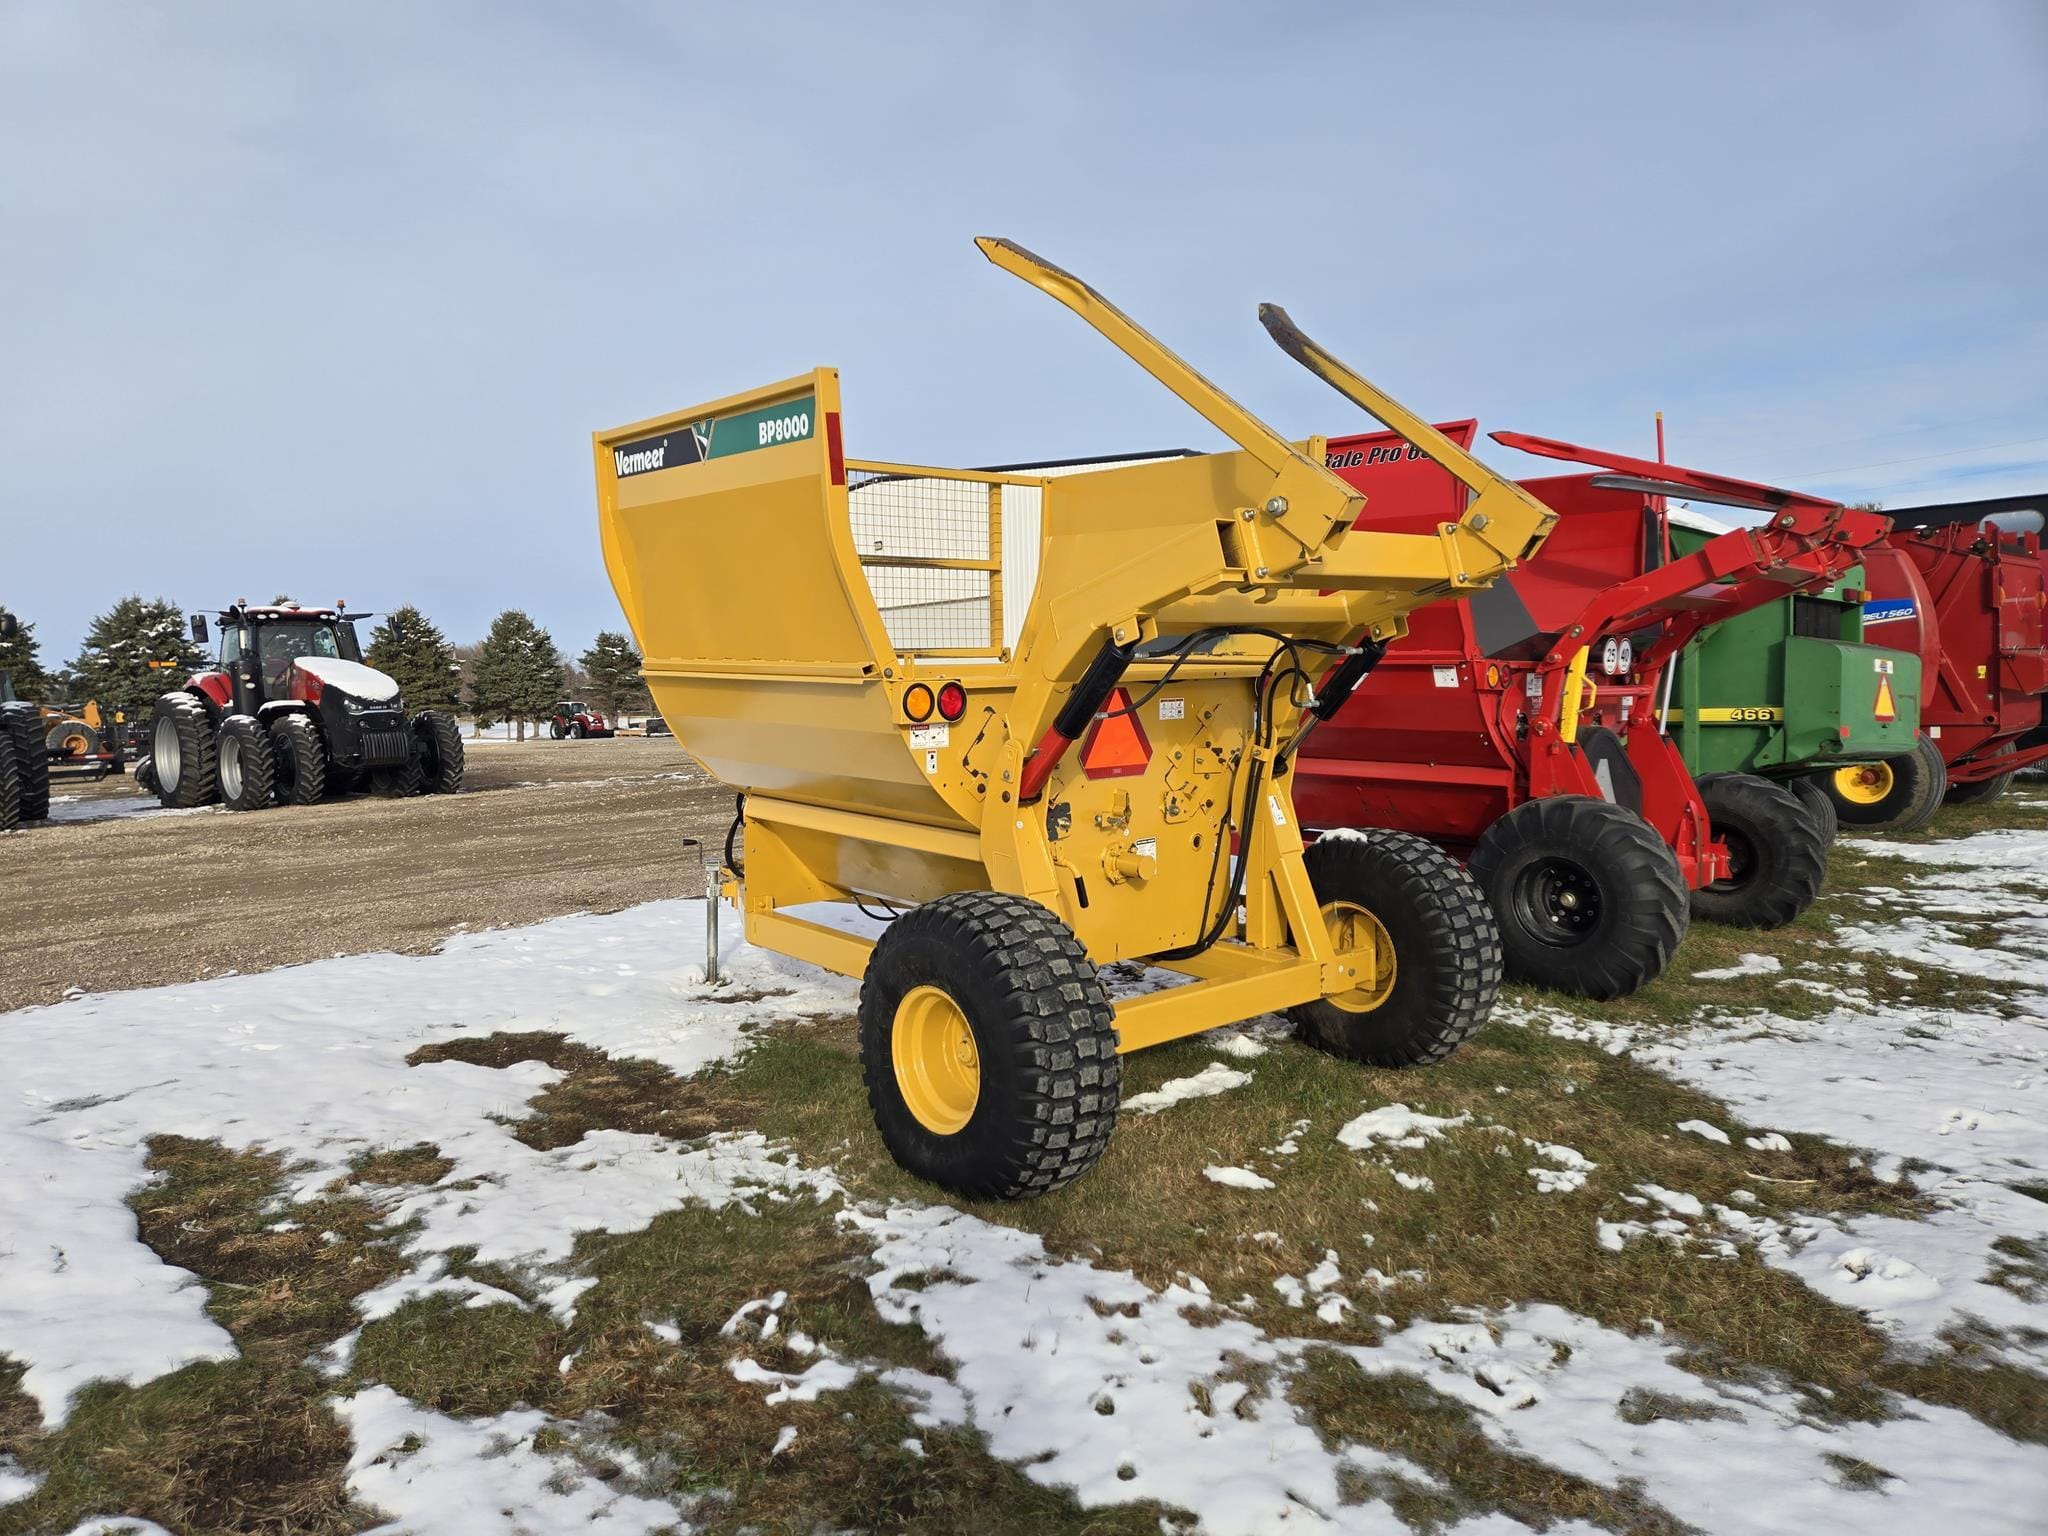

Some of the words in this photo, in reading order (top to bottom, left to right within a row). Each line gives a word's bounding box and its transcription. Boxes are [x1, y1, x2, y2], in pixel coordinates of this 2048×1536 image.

[758, 413, 809, 445] BP8000
[1366, 445, 1402, 465] Pro
[1888, 608, 1913, 618] 560
[1607, 648, 1616, 662] 25
[1620, 648, 1630, 662] 40
[1730, 708, 1774, 720] 466
